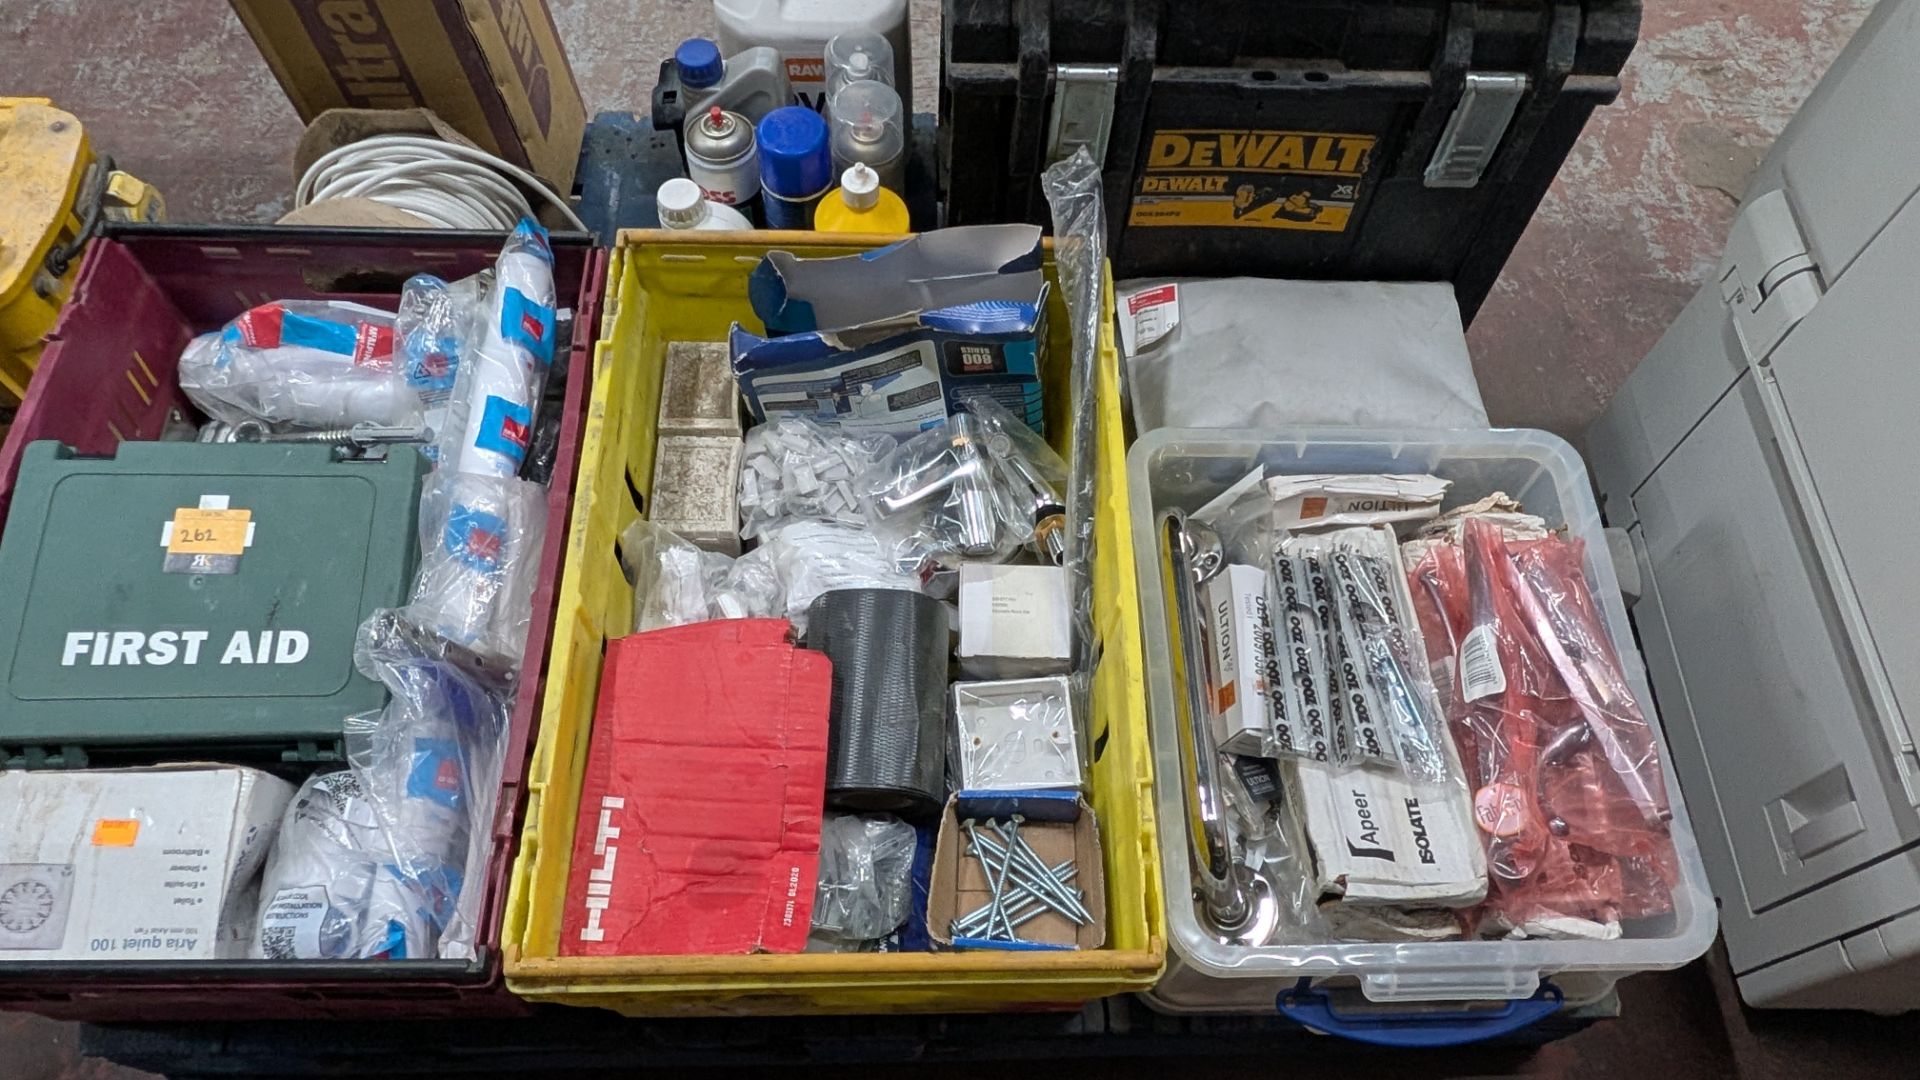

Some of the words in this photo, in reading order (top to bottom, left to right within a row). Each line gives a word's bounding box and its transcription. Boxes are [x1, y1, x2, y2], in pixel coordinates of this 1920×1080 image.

[180, 528, 217, 543] 262
[1218, 600, 1231, 661] ULTION
[61, 631, 209, 666] FIRST
[220, 630, 310, 664] AID
[1352, 789, 1380, 846] Apeer
[1404, 797, 1436, 864] ISOLATE
[162, 849, 203, 857] Bathroom
[169, 865, 200, 873] Shower
[580, 796, 625, 941] HILTI
[173, 897, 195, 905] Toilet
[91, 938, 116, 951] 100
[122, 935, 162, 951] quiet
[166, 938, 198, 951] Aria
